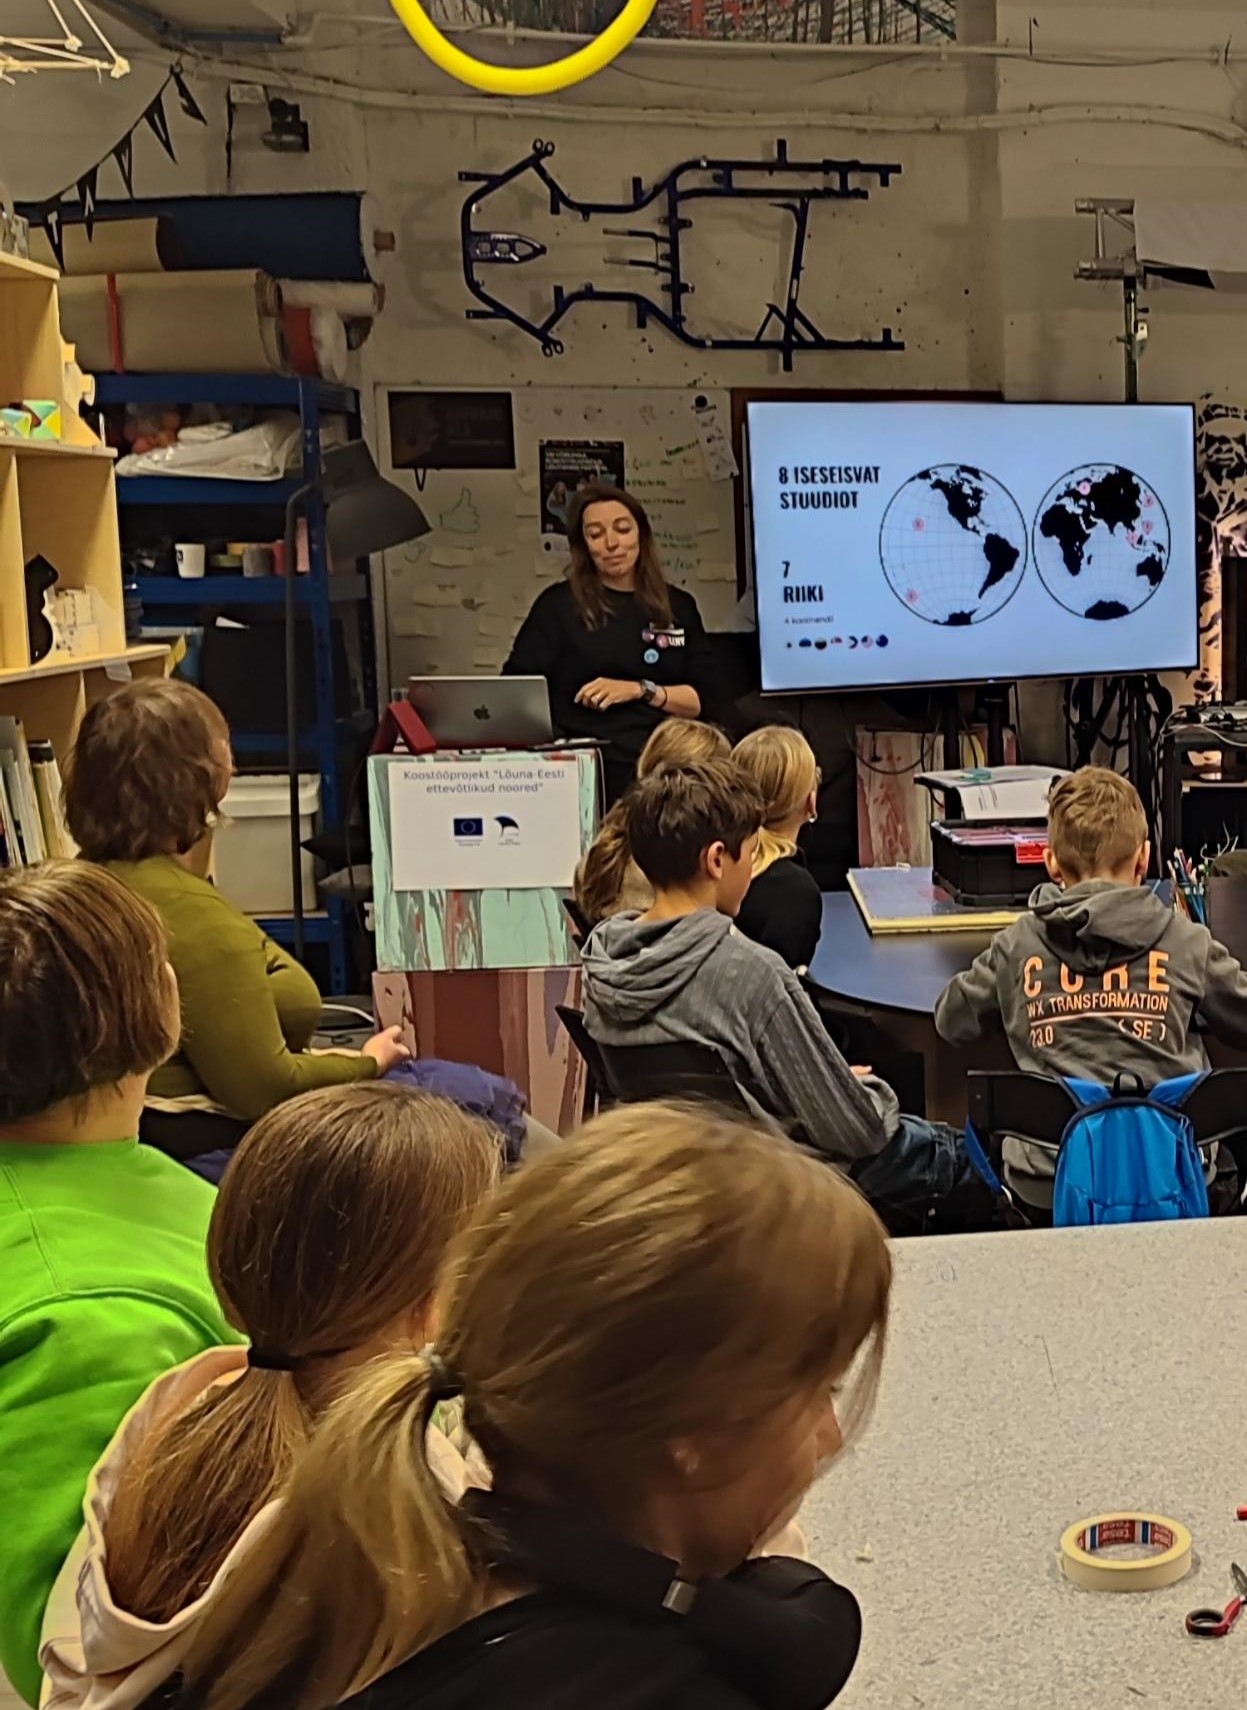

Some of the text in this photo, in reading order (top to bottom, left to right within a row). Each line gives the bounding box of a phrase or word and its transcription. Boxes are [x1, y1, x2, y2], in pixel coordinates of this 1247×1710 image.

[779, 466, 880, 484] 8 ISESEISVAT
[780, 491, 859, 510] STUUDIOT
[781, 560, 790, 579] 7
[783, 584, 824, 603] RIIKI
[403, 770, 490, 782] Koostööprojekt
[426, 783, 495, 793] ettevõtlikud
[1049, 992, 1169, 1014] TRANSFORMATION
